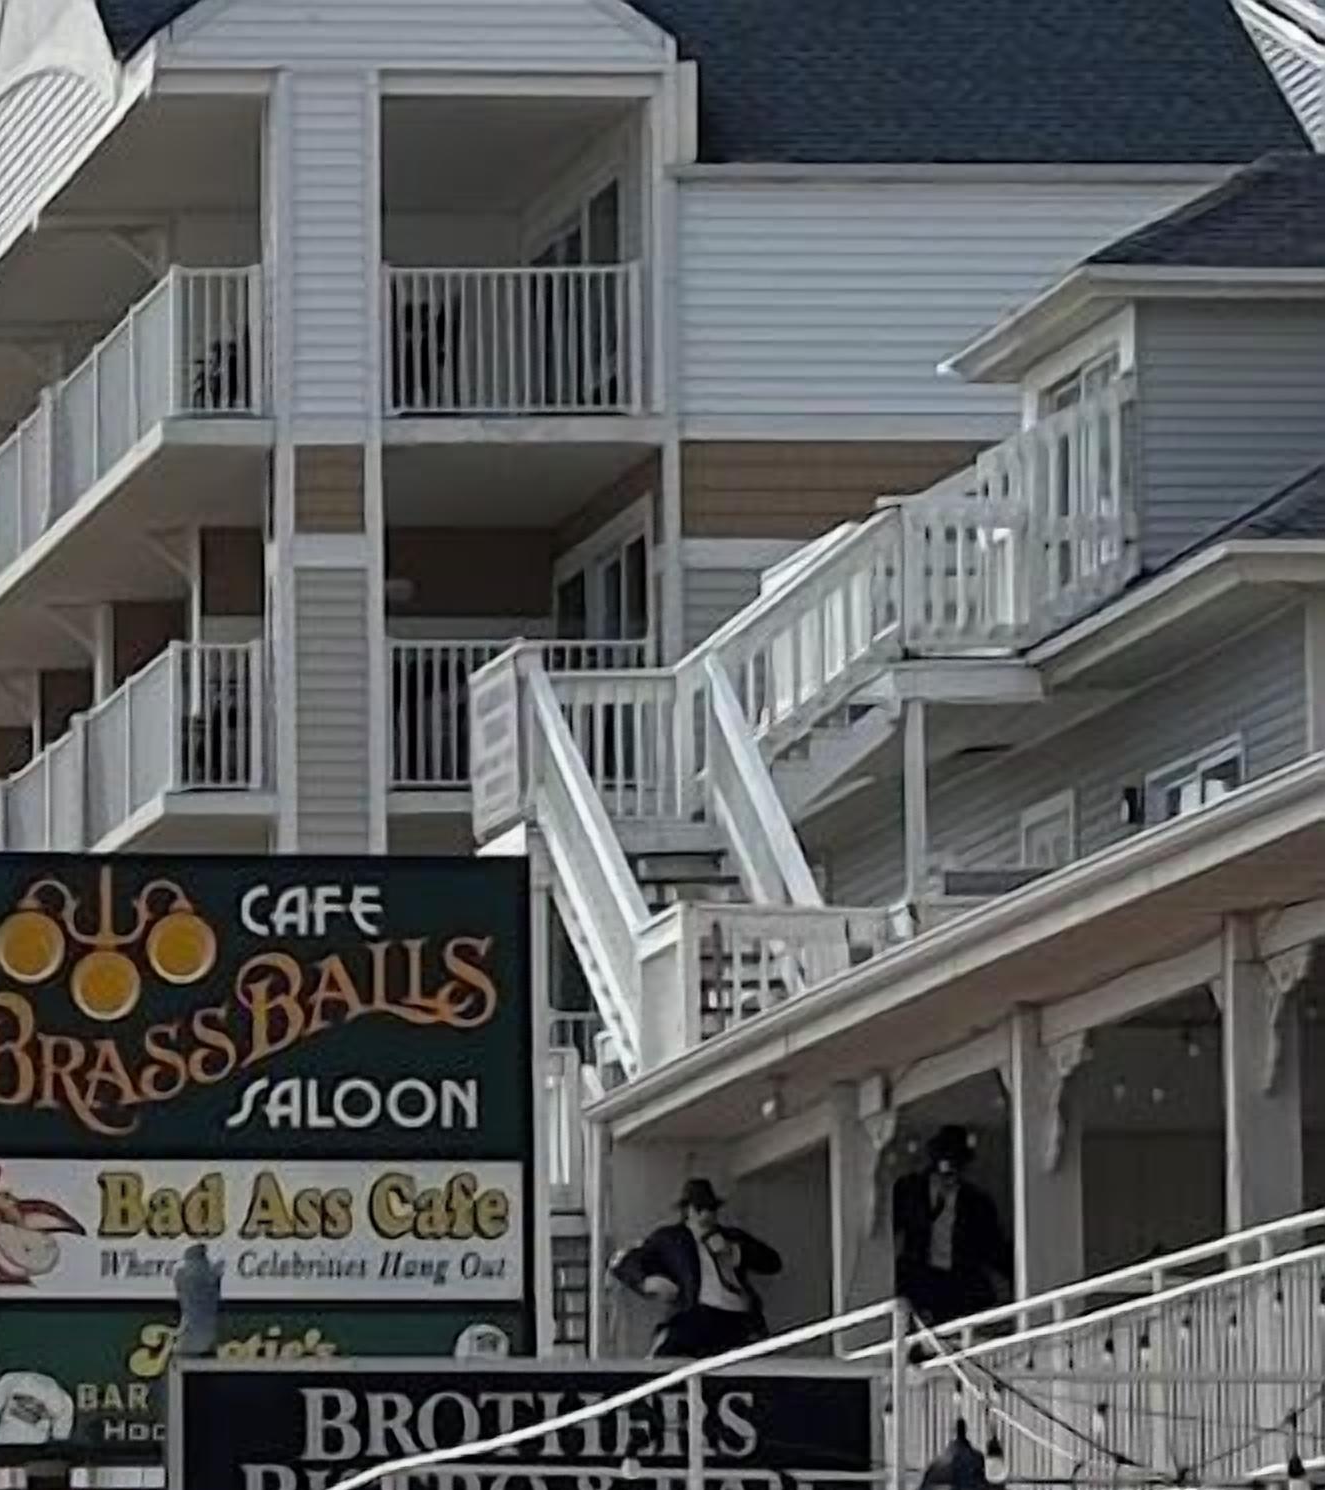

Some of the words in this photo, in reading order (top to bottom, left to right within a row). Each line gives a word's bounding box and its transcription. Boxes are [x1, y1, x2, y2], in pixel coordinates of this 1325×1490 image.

[240, 884, 383, 937] CAFE
[235, 935, 499, 1068] BALLS
[226, 1076, 480, 1130] SALOON
[97, 1171, 228, 1240] Bad
[239, 1172, 354, 1240] Ass
[370, 1171, 511, 1242] Cafe
[235, 1250, 368, 1280] Celebrities
[376, 1250, 450, 1286] Hang
[459, 1250, 507, 1280] Out
[77, 1383, 150, 1410] BAR
[299, 1387, 758, 1462] BROTHERS
